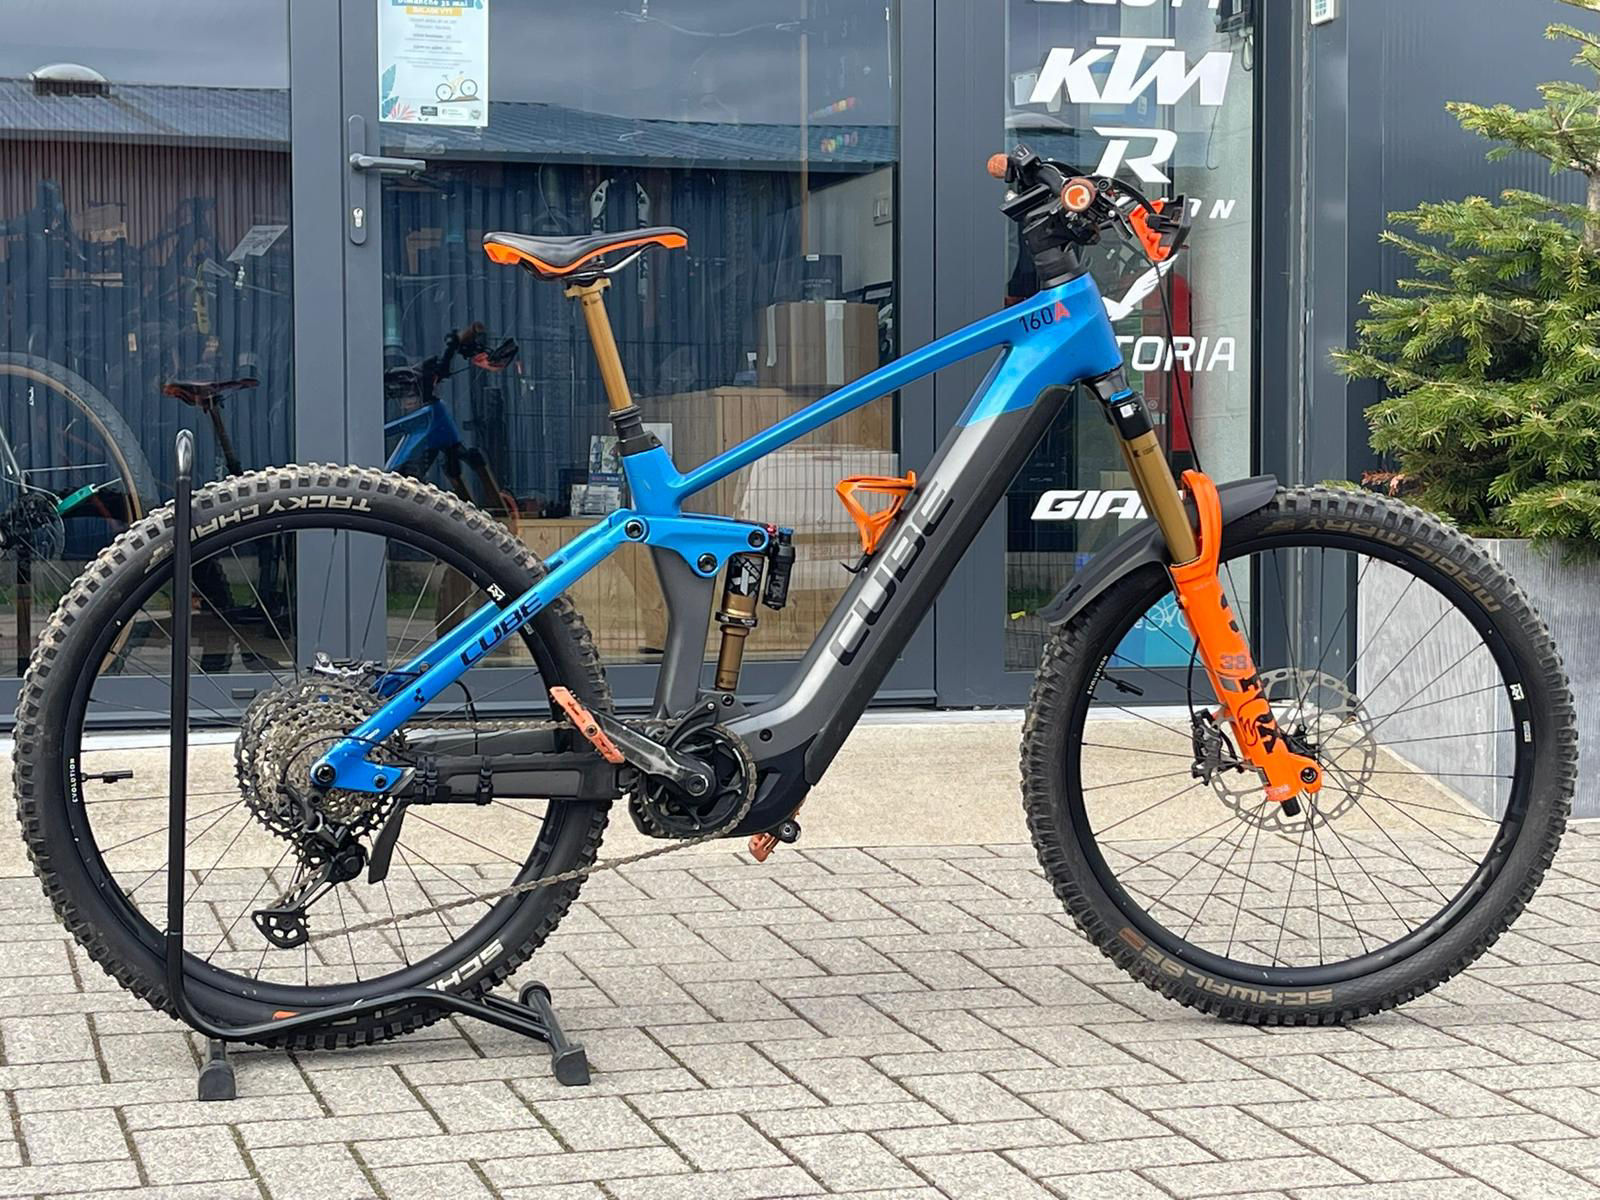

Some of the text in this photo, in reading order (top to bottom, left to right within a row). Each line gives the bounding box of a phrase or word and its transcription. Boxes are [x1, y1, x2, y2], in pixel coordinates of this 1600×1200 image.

[1029, 37, 1233, 106] KTM
[266, 495, 372, 515] TACKY
[1031, 490, 1184, 520] GIA
[830, 481, 954, 666] CUBE
[1305, 518, 1501, 614] MAGIC MARY
[461, 592, 543, 667] CUBE
[1220, 654, 1248, 670] 38
[1141, 947, 1333, 1006] SCHWALBE
